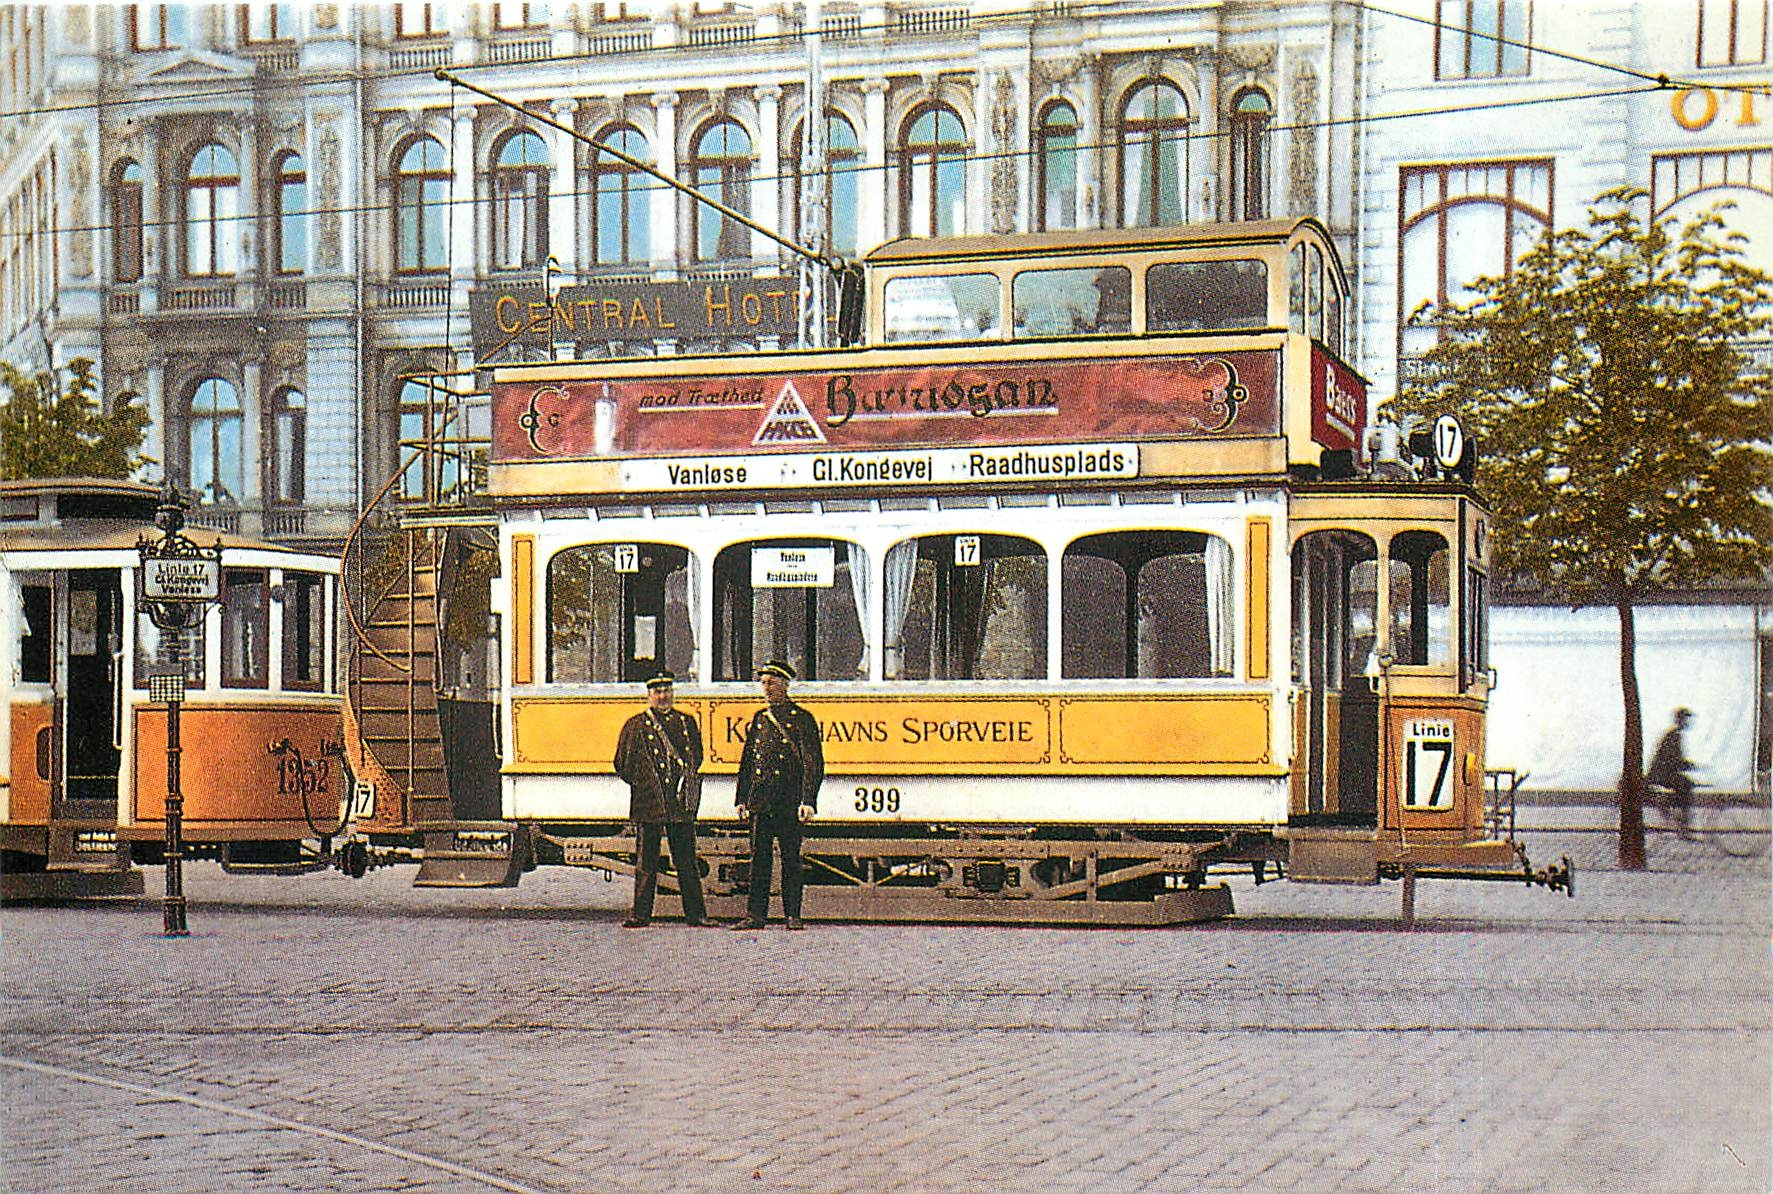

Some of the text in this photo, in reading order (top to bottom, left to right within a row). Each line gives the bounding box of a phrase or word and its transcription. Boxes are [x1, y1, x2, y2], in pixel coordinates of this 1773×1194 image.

[494, 287, 838, 334] CENTRAL HOTE
[639, 389, 681, 407] mod
[1439, 424, 1457, 458] 17
[668, 464, 747, 485] Vanløse
[970, 449, 1124, 477] Raadhusplads
[620, 553, 634, 570] 17
[960, 544, 976, 562] 17
[903, 717, 1034, 744] SPORVEIE
[1413, 723, 1450, 738] Linie
[1406, 741, 1453, 806] 17
[355, 788, 371, 814] 17
[855, 788, 900, 812] 399
